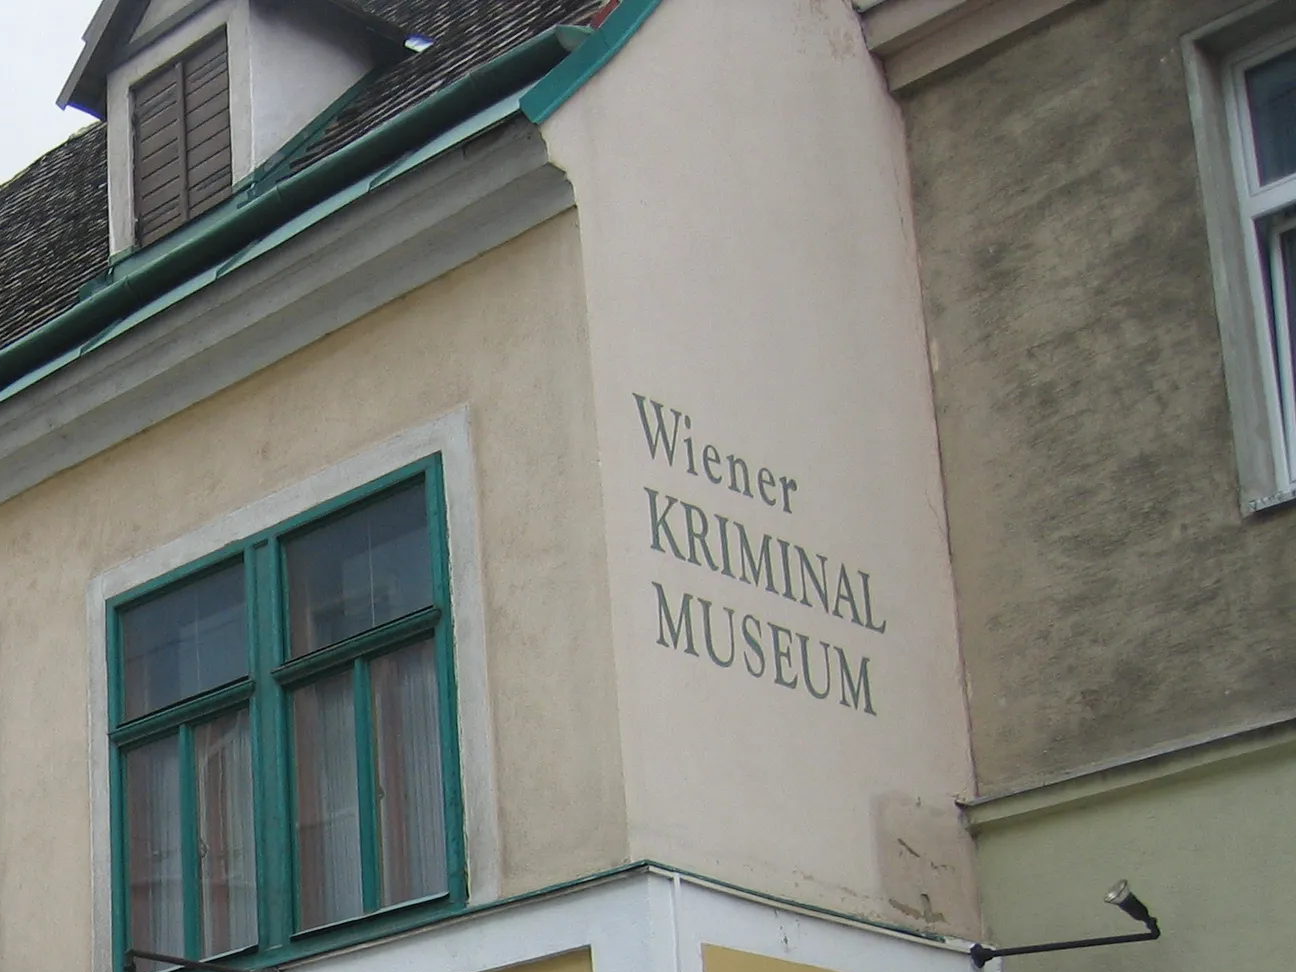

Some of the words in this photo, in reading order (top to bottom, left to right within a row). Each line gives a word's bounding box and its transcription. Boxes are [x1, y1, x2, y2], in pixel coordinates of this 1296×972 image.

[631, 392, 798, 514] Wiener
[643, 487, 887, 634] KRIMINAL
[651, 581, 878, 716] MUSEUM
